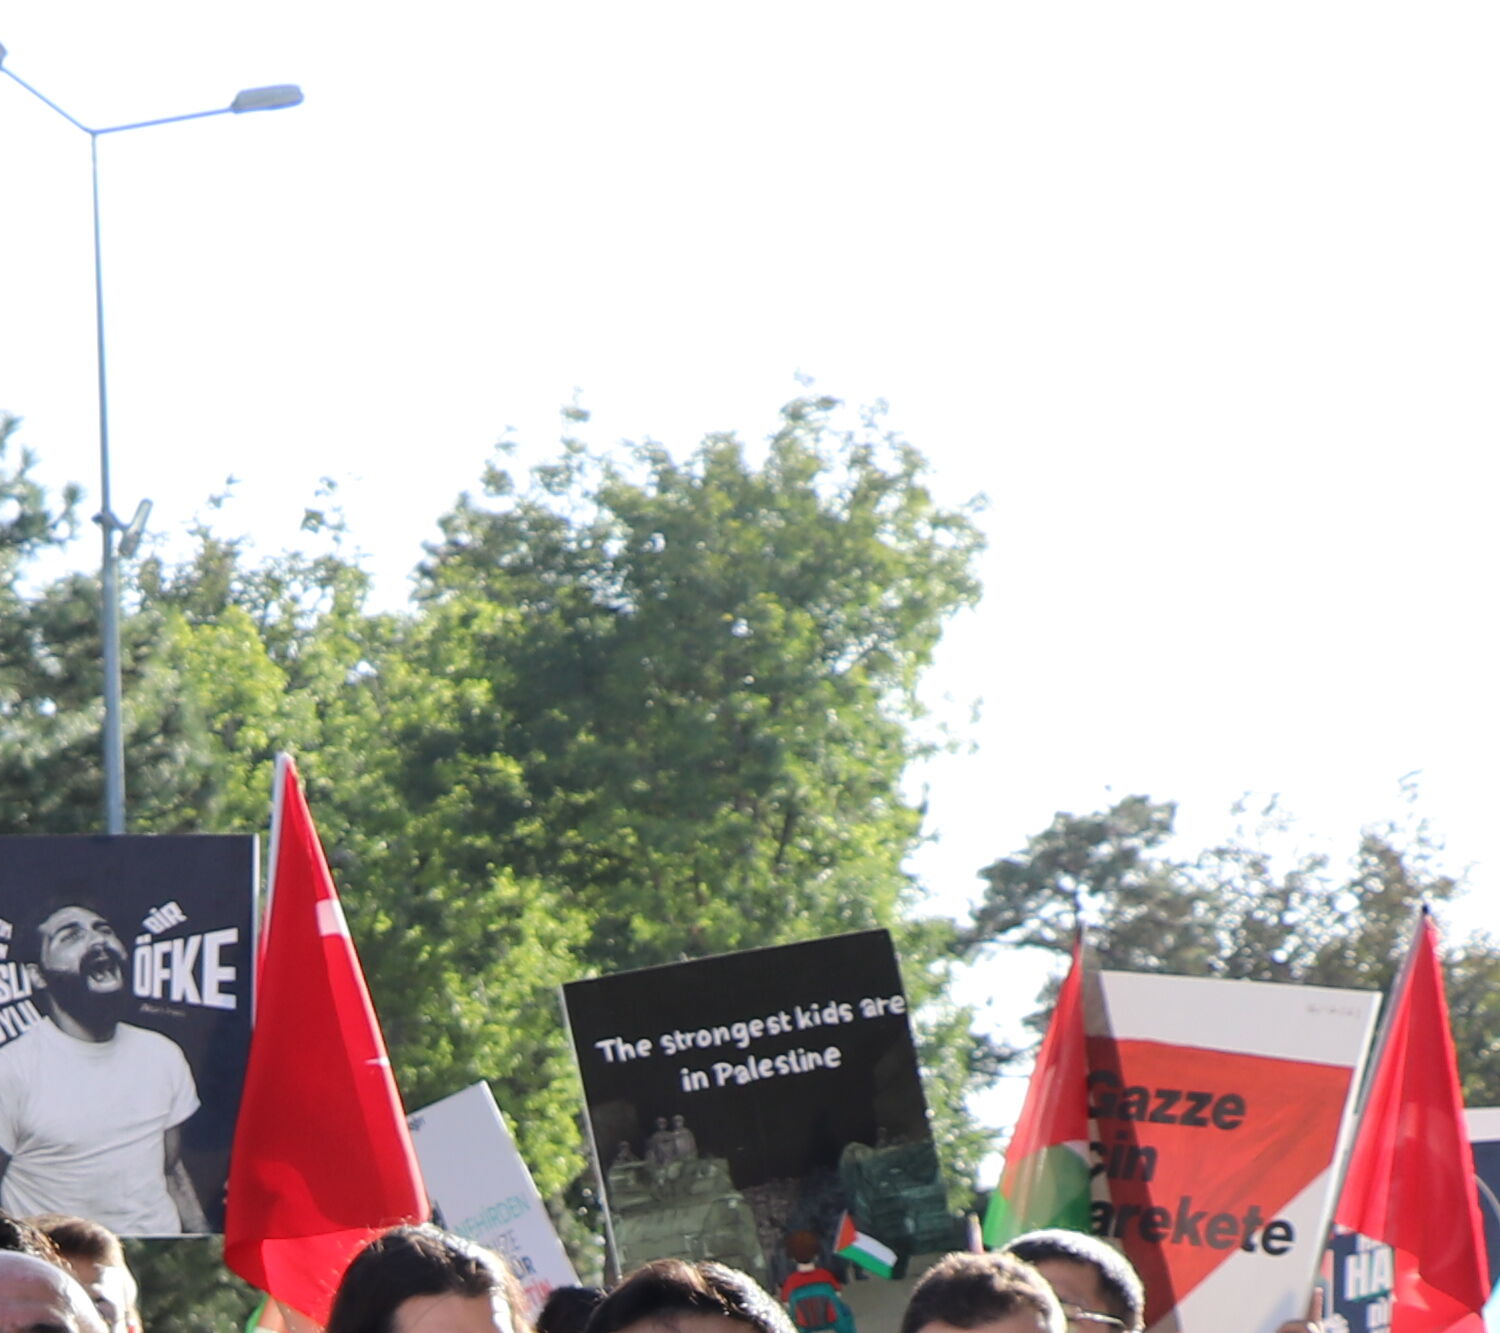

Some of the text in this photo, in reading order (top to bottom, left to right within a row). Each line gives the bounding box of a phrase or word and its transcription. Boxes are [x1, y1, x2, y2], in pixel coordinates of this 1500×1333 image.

[142, 901, 188, 935] BİR
[133, 927, 239, 1011] ÖFKE
[594, 993, 906, 1063] The strongest kids are
[680, 1046, 842, 1093] in Palestine
[1088, 1069, 1247, 1131] Gazze
[1090, 1195, 1295, 1256] arekete
